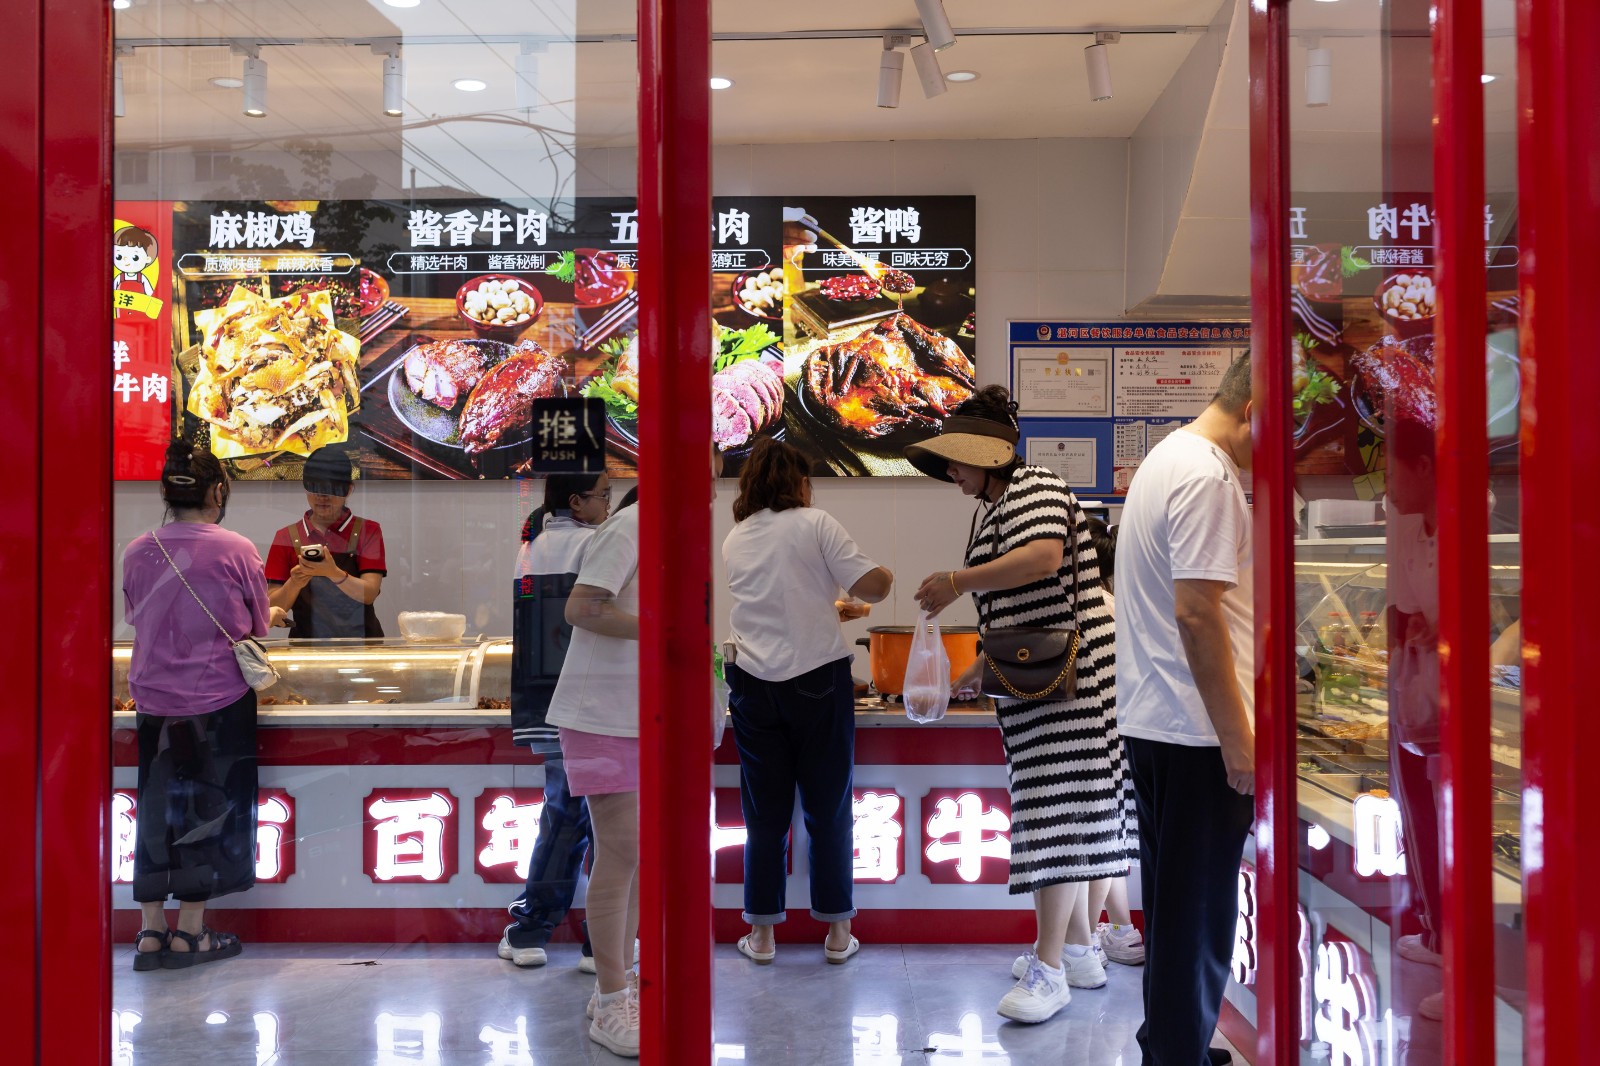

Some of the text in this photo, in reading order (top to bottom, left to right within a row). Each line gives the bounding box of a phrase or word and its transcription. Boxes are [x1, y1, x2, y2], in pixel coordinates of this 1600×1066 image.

[208, 210, 315, 249] 麻椒鸡
[407, 208, 548, 247] 酱香牛肉
[849, 206, 921, 244] 酱鸭
[204, 256, 334, 273] 质嫩味鲜 麻辣浓香
[410, 254, 545, 271] 精选牛肉 酱香秘制
[891, 251, 949, 267] 回味无穷
[113, 372, 169, 403] 牛肉
[538, 410, 577, 448] 推
[541, 451, 576, 461] PUSH
